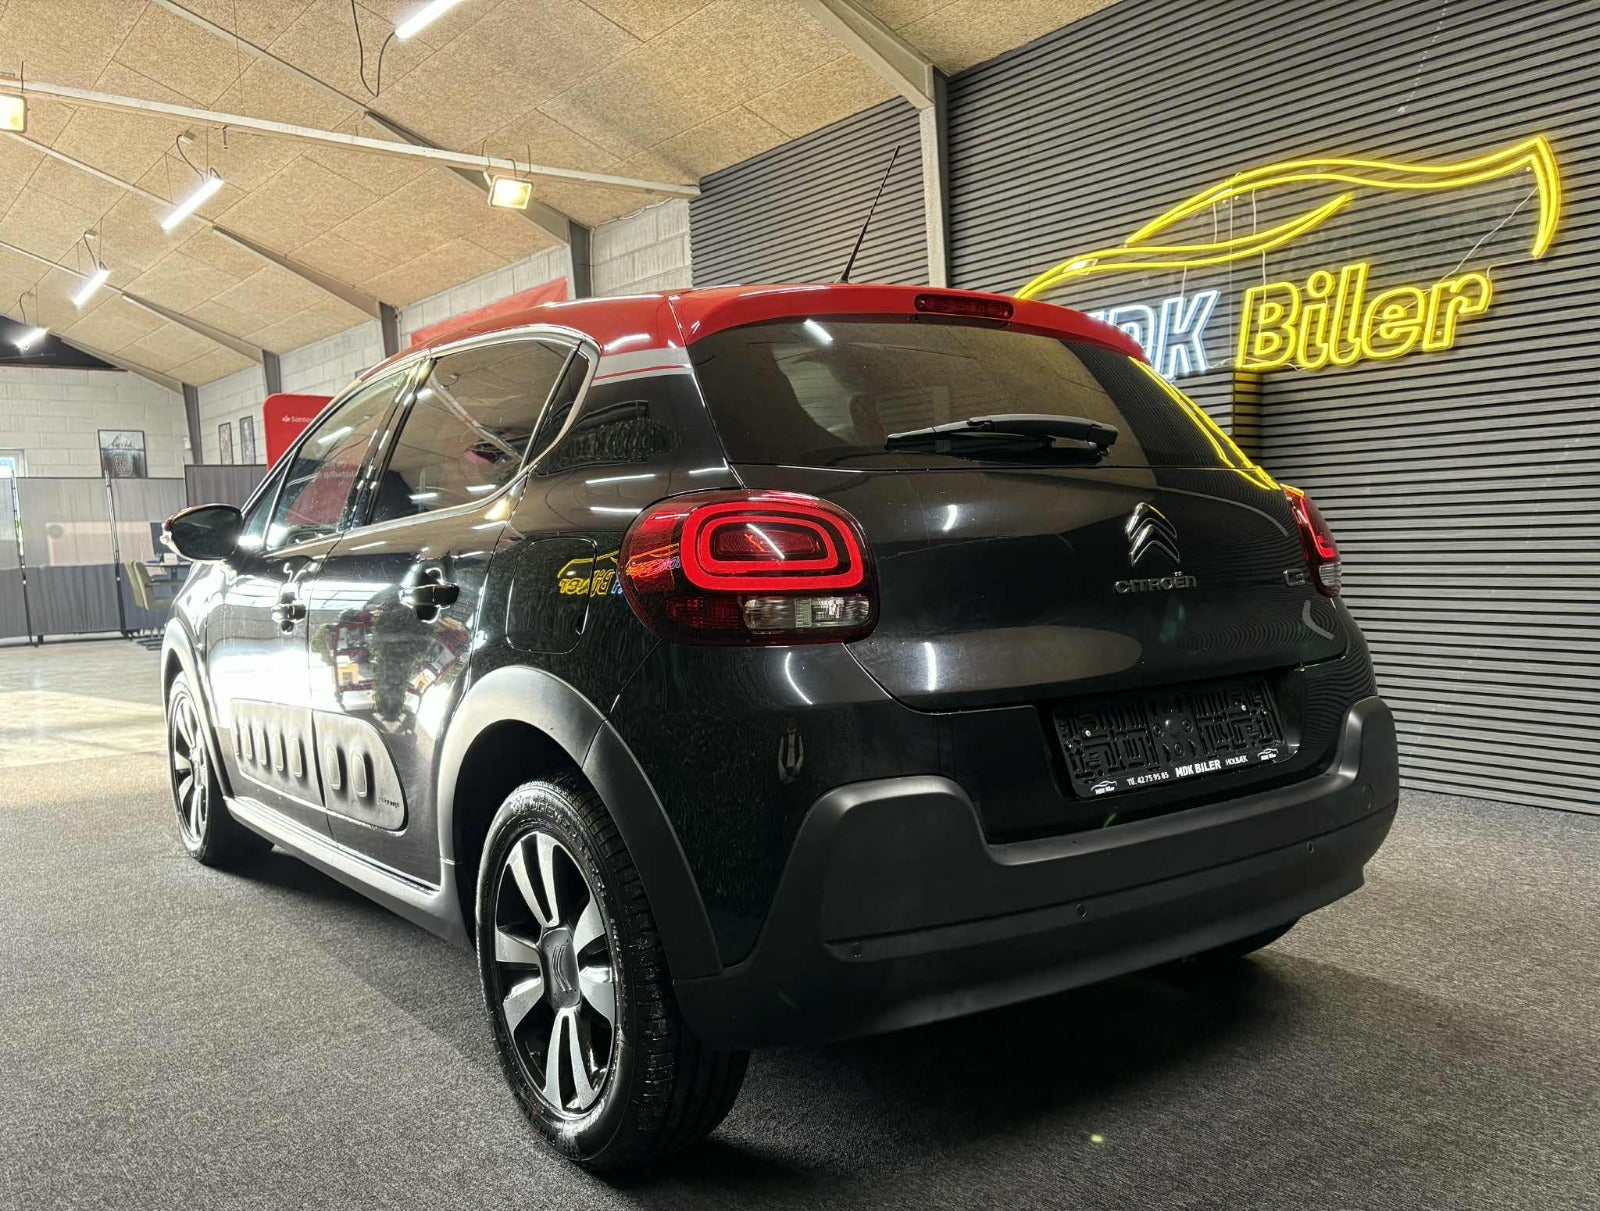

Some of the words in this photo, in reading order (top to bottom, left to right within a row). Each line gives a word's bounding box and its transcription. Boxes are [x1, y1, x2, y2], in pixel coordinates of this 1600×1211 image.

[1087, 290, 1221, 383] DK
[1234, 262, 1492, 371] Biler
[1175, 764, 1195, 778] MDK
[1195, 759, 1221, 774] BILER
